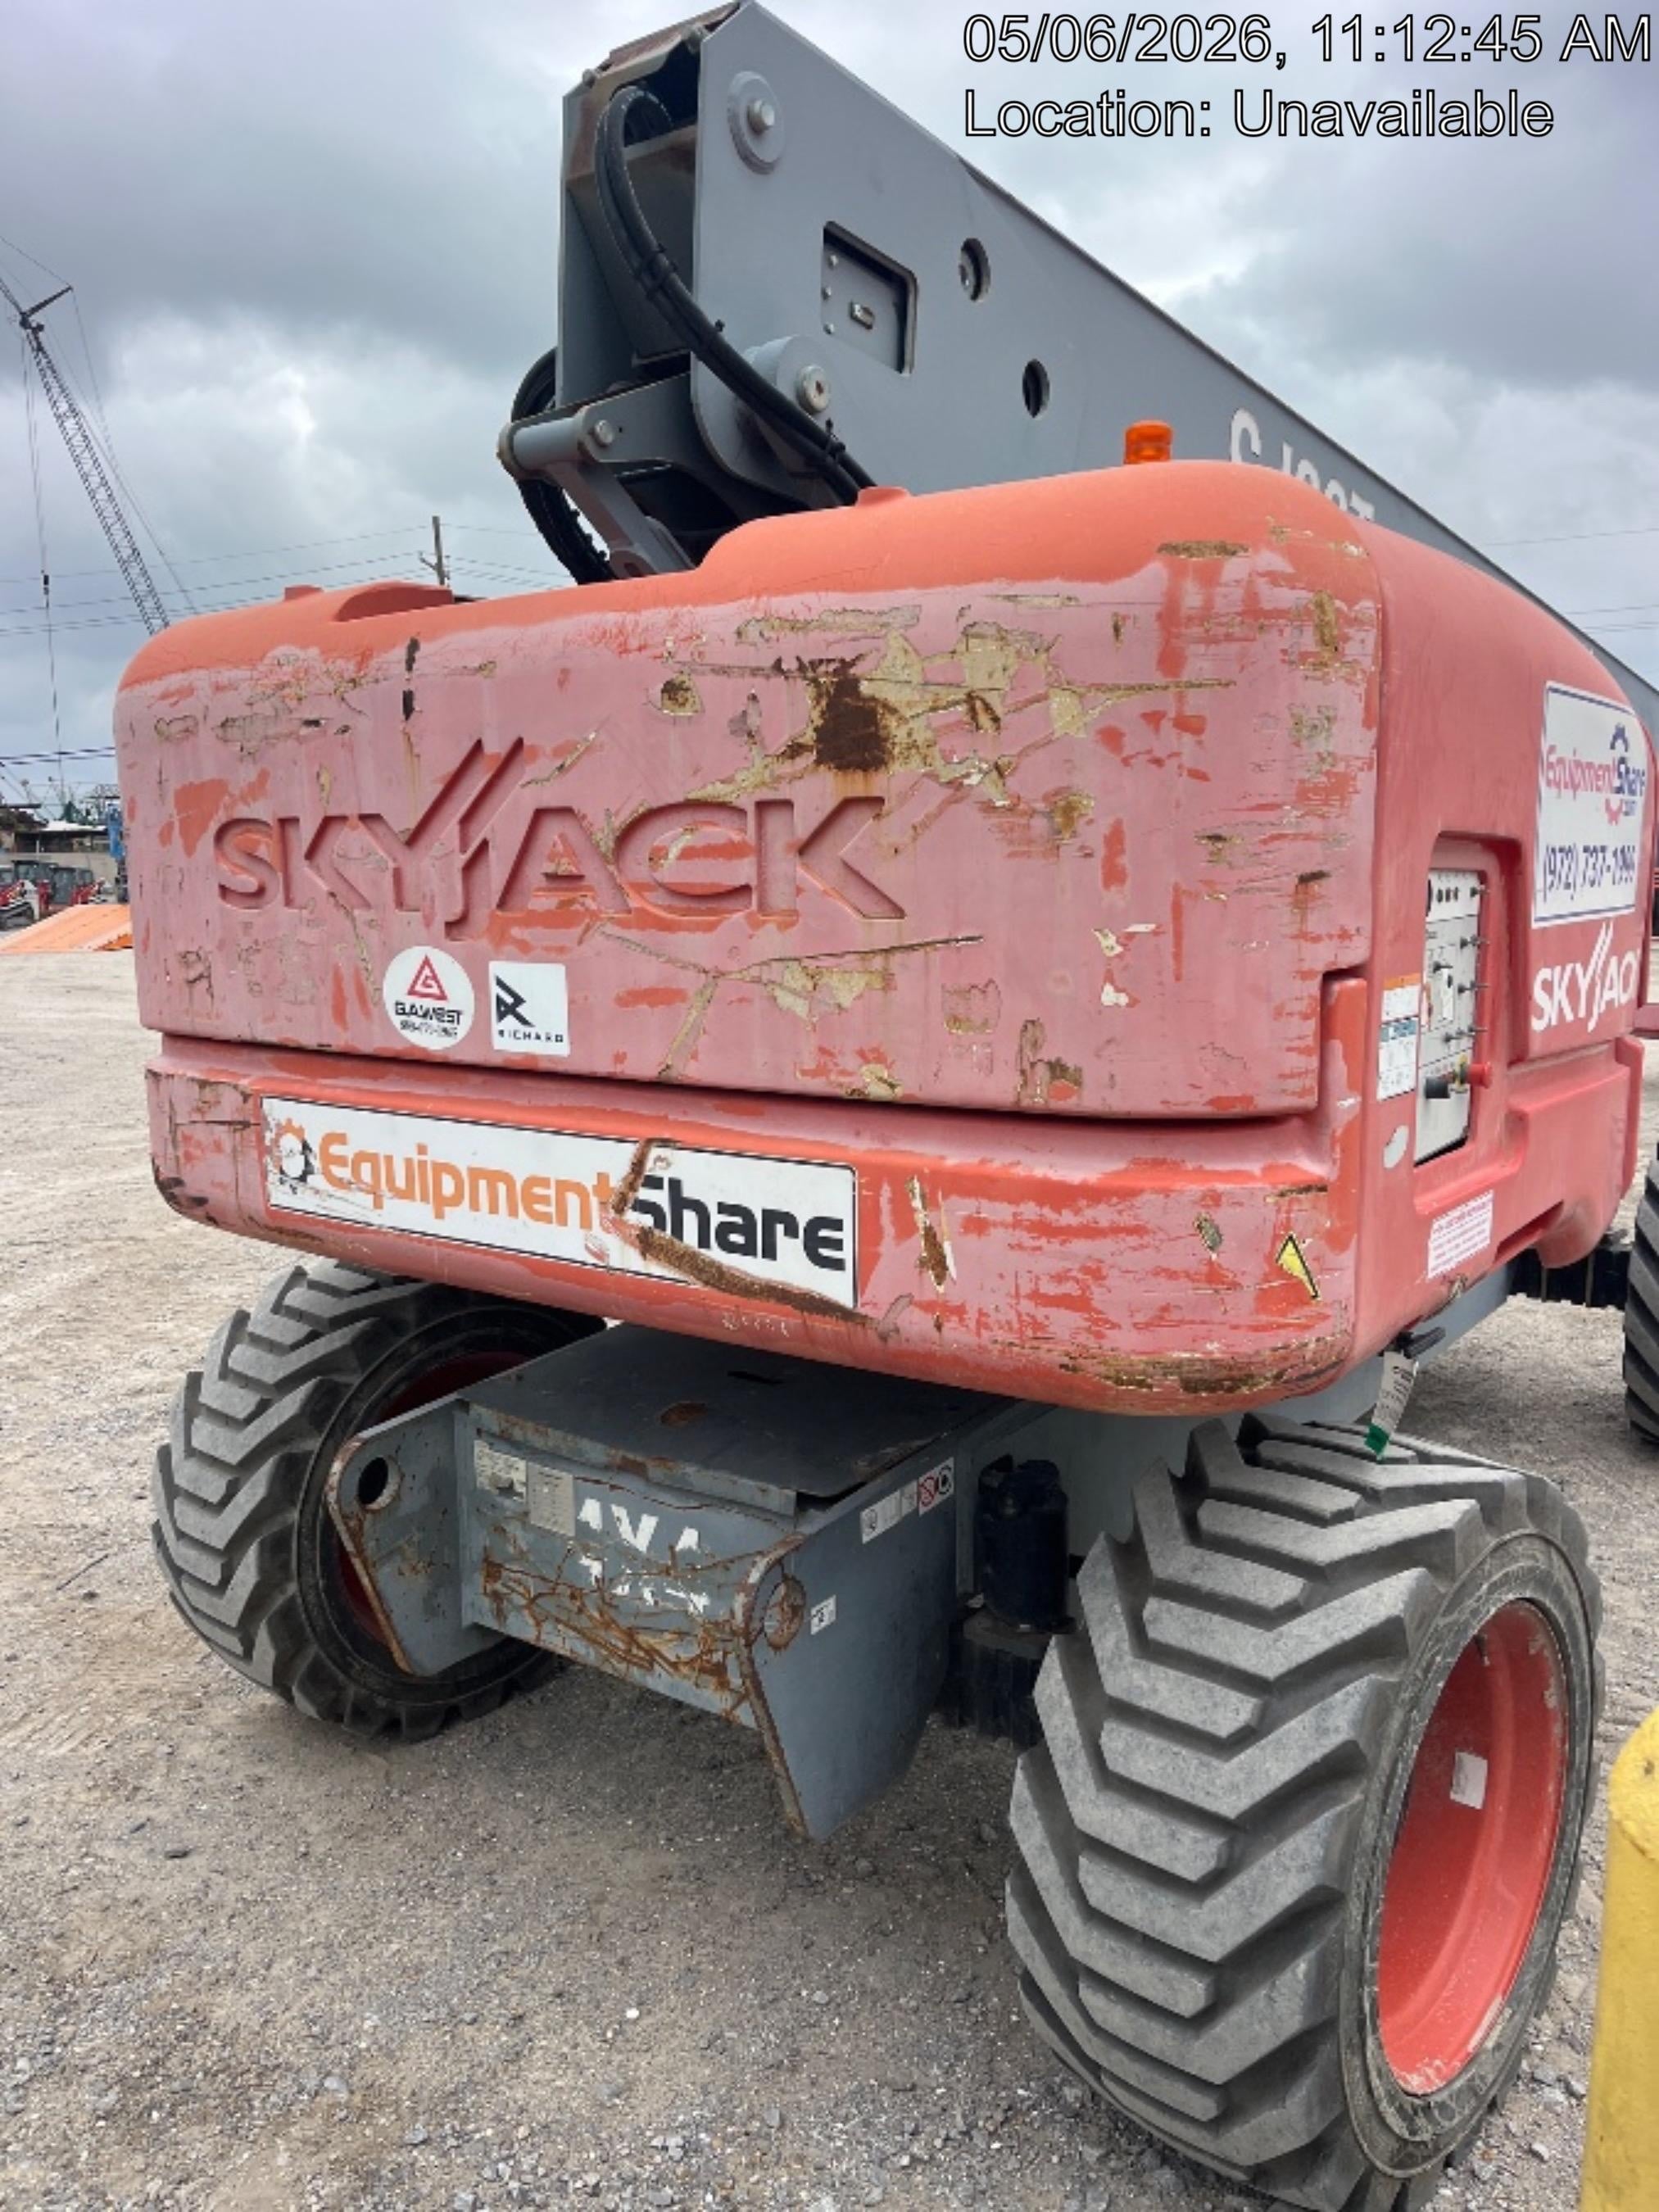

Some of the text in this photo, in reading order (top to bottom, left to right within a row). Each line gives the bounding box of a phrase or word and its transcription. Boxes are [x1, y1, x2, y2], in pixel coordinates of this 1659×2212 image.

[214, 737, 907, 942] SKYJACK
[1543, 843, 1578, 903] (972)
[1530, 920, 1641, 1033] SKYJAC
